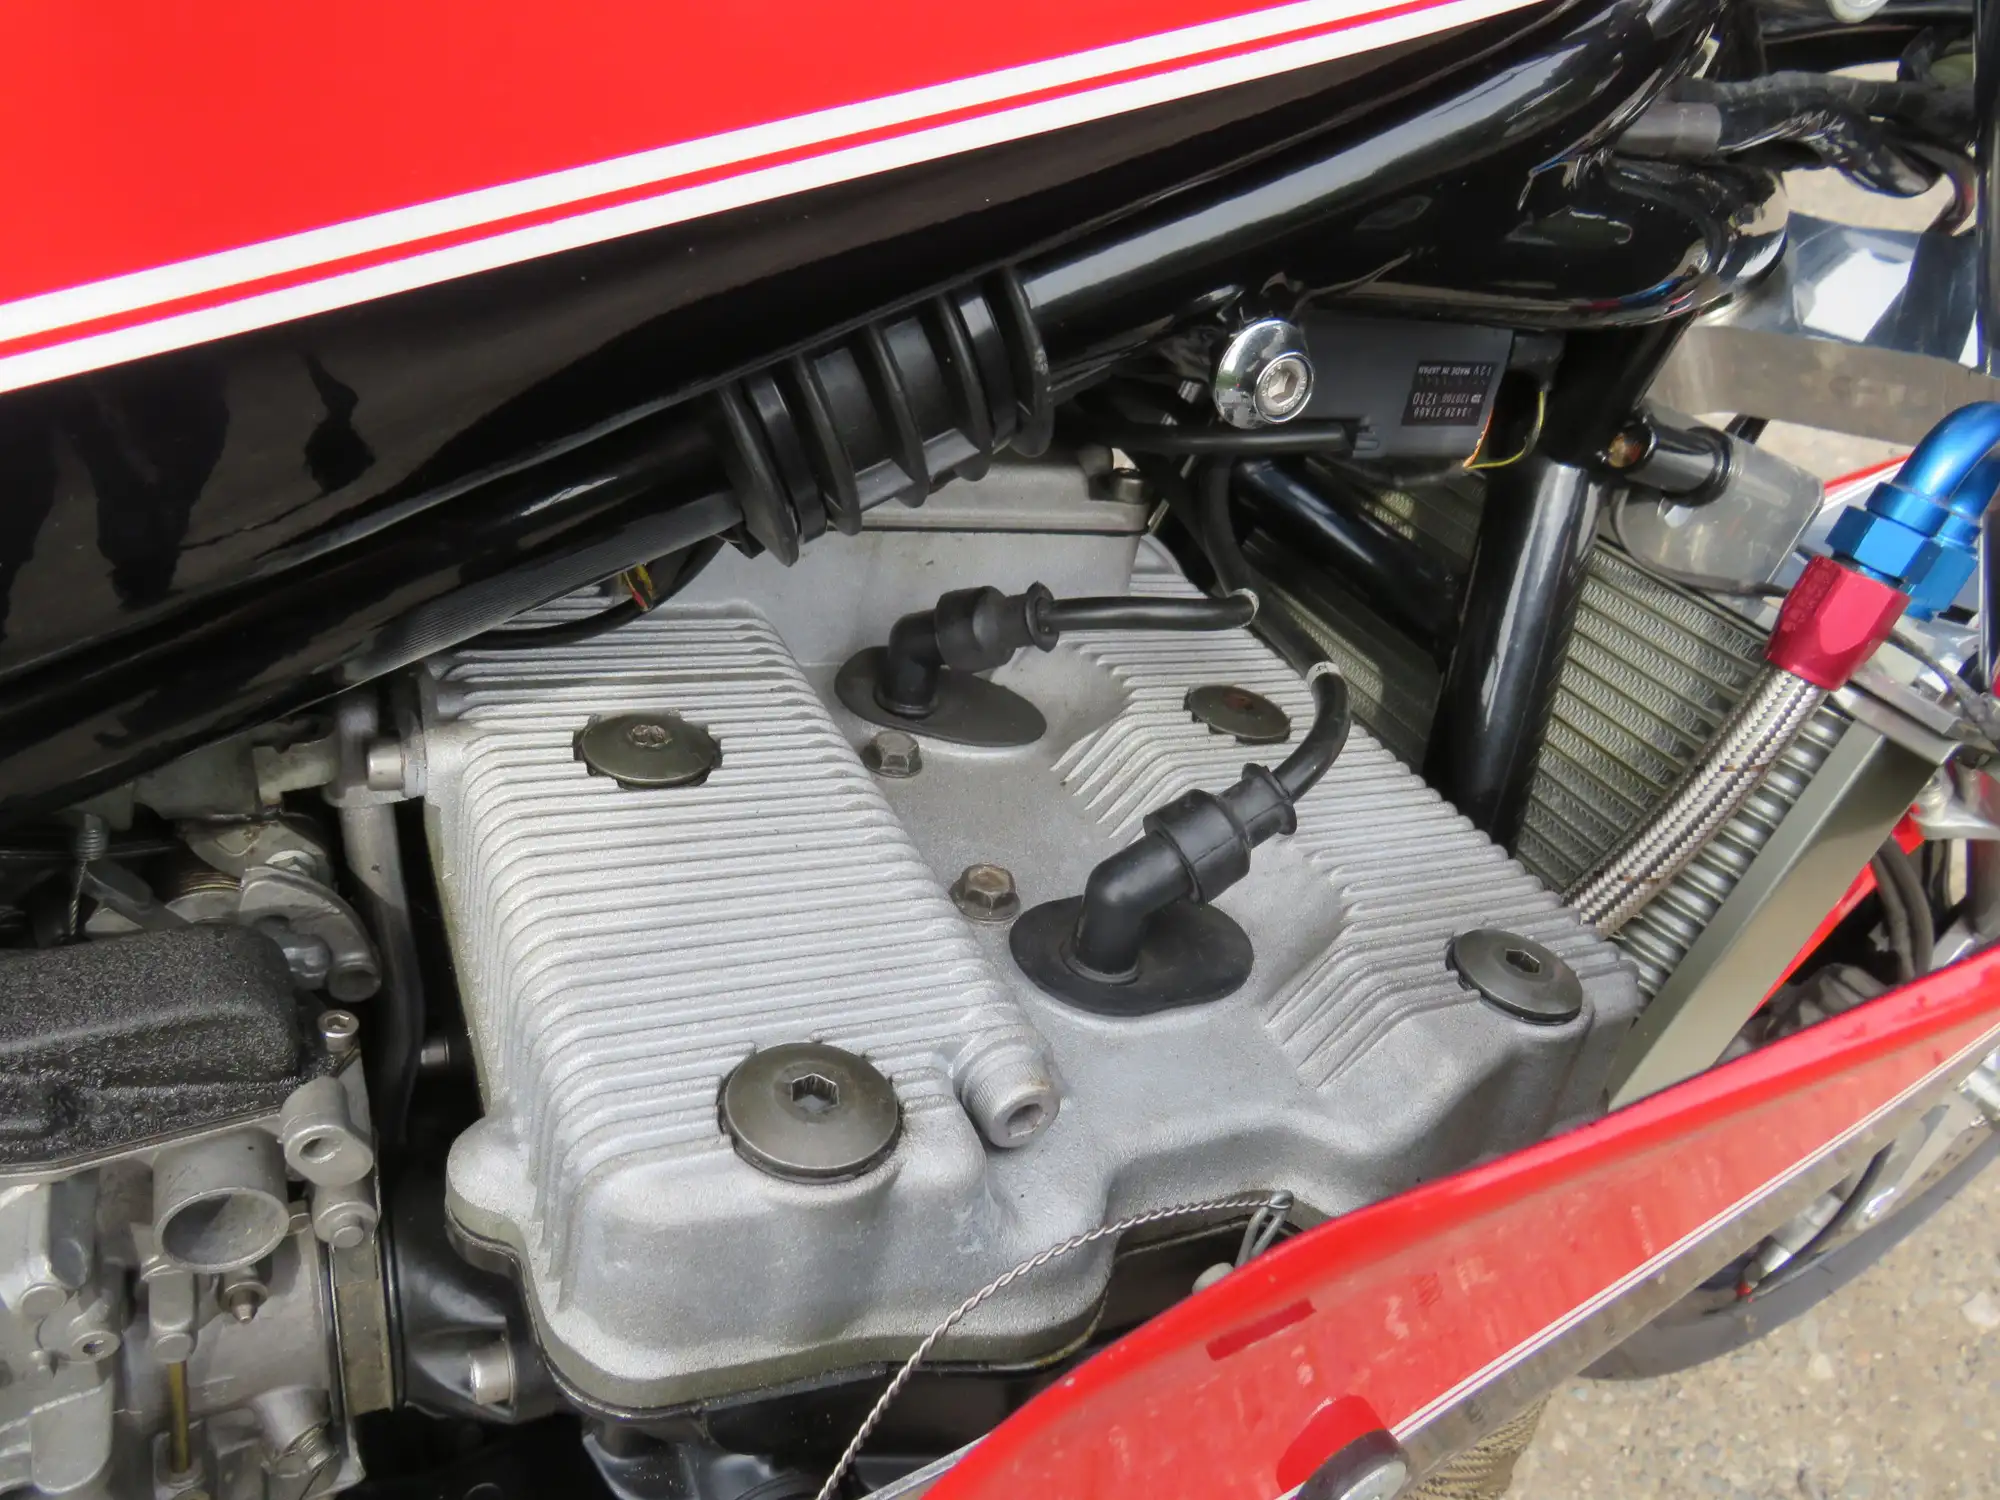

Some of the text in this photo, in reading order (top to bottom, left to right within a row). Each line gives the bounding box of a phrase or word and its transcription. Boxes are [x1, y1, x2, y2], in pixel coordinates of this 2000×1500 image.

[1418, 365, 1491, 376] 12V MADE IN JAPAN
